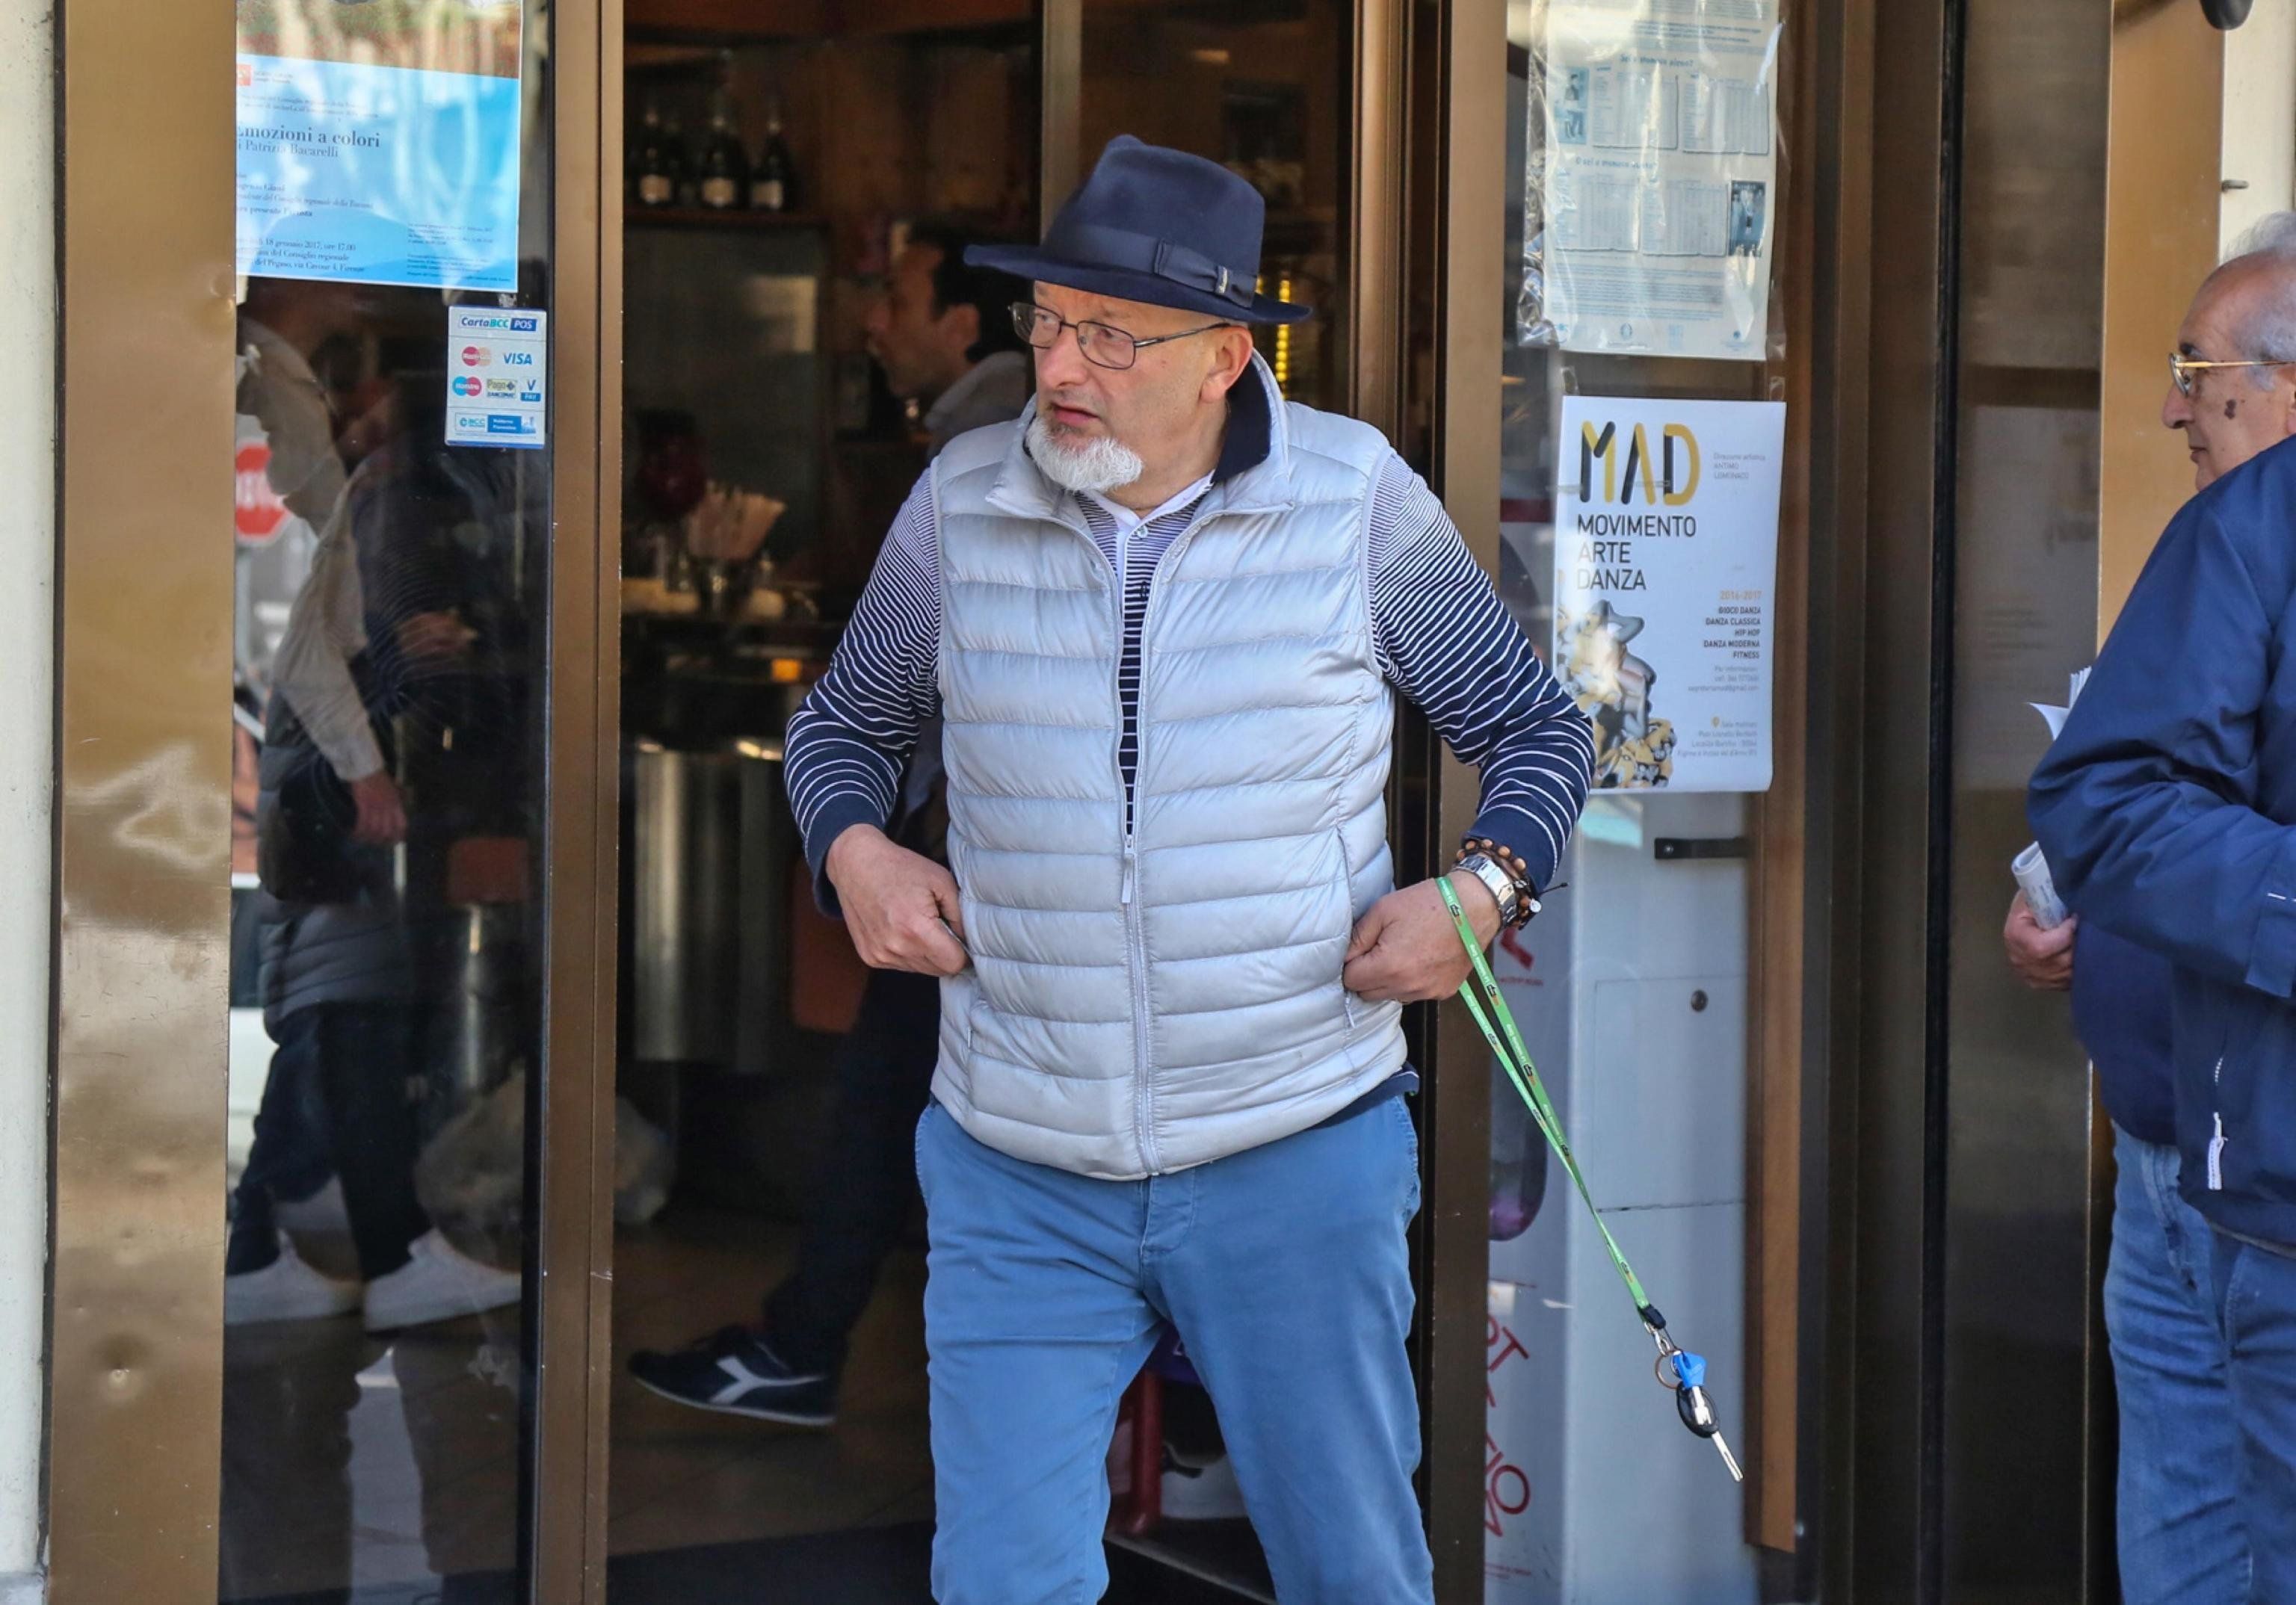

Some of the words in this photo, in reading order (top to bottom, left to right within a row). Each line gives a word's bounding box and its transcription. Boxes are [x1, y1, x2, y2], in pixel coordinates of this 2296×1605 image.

[318, 133, 327, 143] a
[333, 130, 380, 147] colori
[461, 317, 509, 328] CartaBCC
[513, 320, 533, 329] POS
[503, 352, 533, 365] VISA
[1579, 421, 1700, 506] MAD
[1578, 514, 1697, 537] MOVIMENTO
[1578, 542, 1632, 563] ARTE
[1578, 569, 1647, 590] DANZA
[1740, 606, 1761, 614] DANZA
[1706, 617, 1729, 625] DANZA
[1730, 617, 1761, 625] CLASSICA
[1734, 628, 1747, 637] HIP
[1747, 628, 1761, 637] HOP
[1703, 640, 1726, 648] DANZA
[1728, 640, 1760, 648] MODERNA
[1732, 651, 1759, 659] FITNESS
